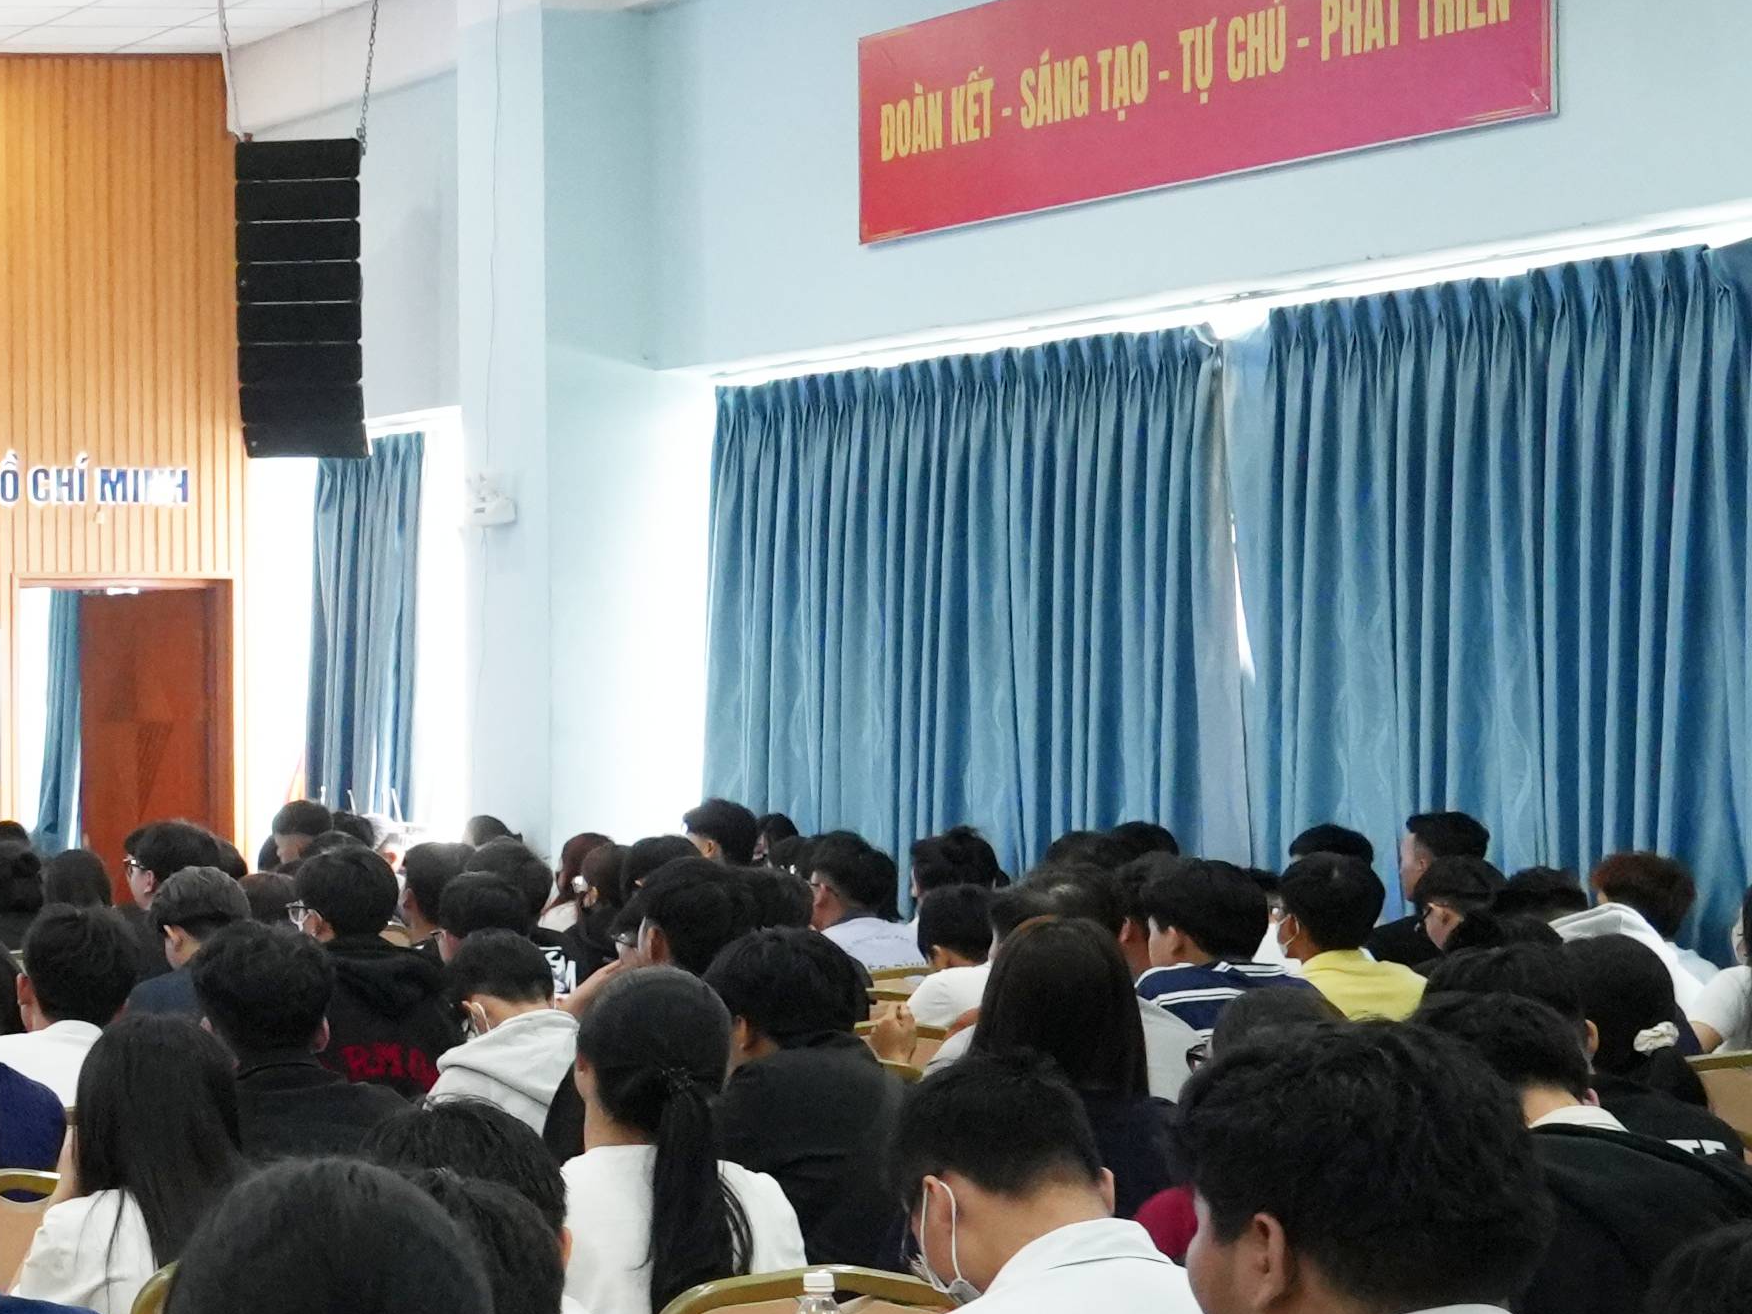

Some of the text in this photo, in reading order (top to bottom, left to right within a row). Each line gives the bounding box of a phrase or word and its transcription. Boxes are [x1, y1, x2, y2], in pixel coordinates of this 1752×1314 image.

[880, 82, 944, 163] ĐOÀN
[951, 66, 994, 145] KẾT
[1020, 49, 1090, 130] SÁNG
[1097, 40, 1149, 121] TẠO
[1178, 17, 1218, 104] TỰ
[32, 456, 88, 503] CHÍ
